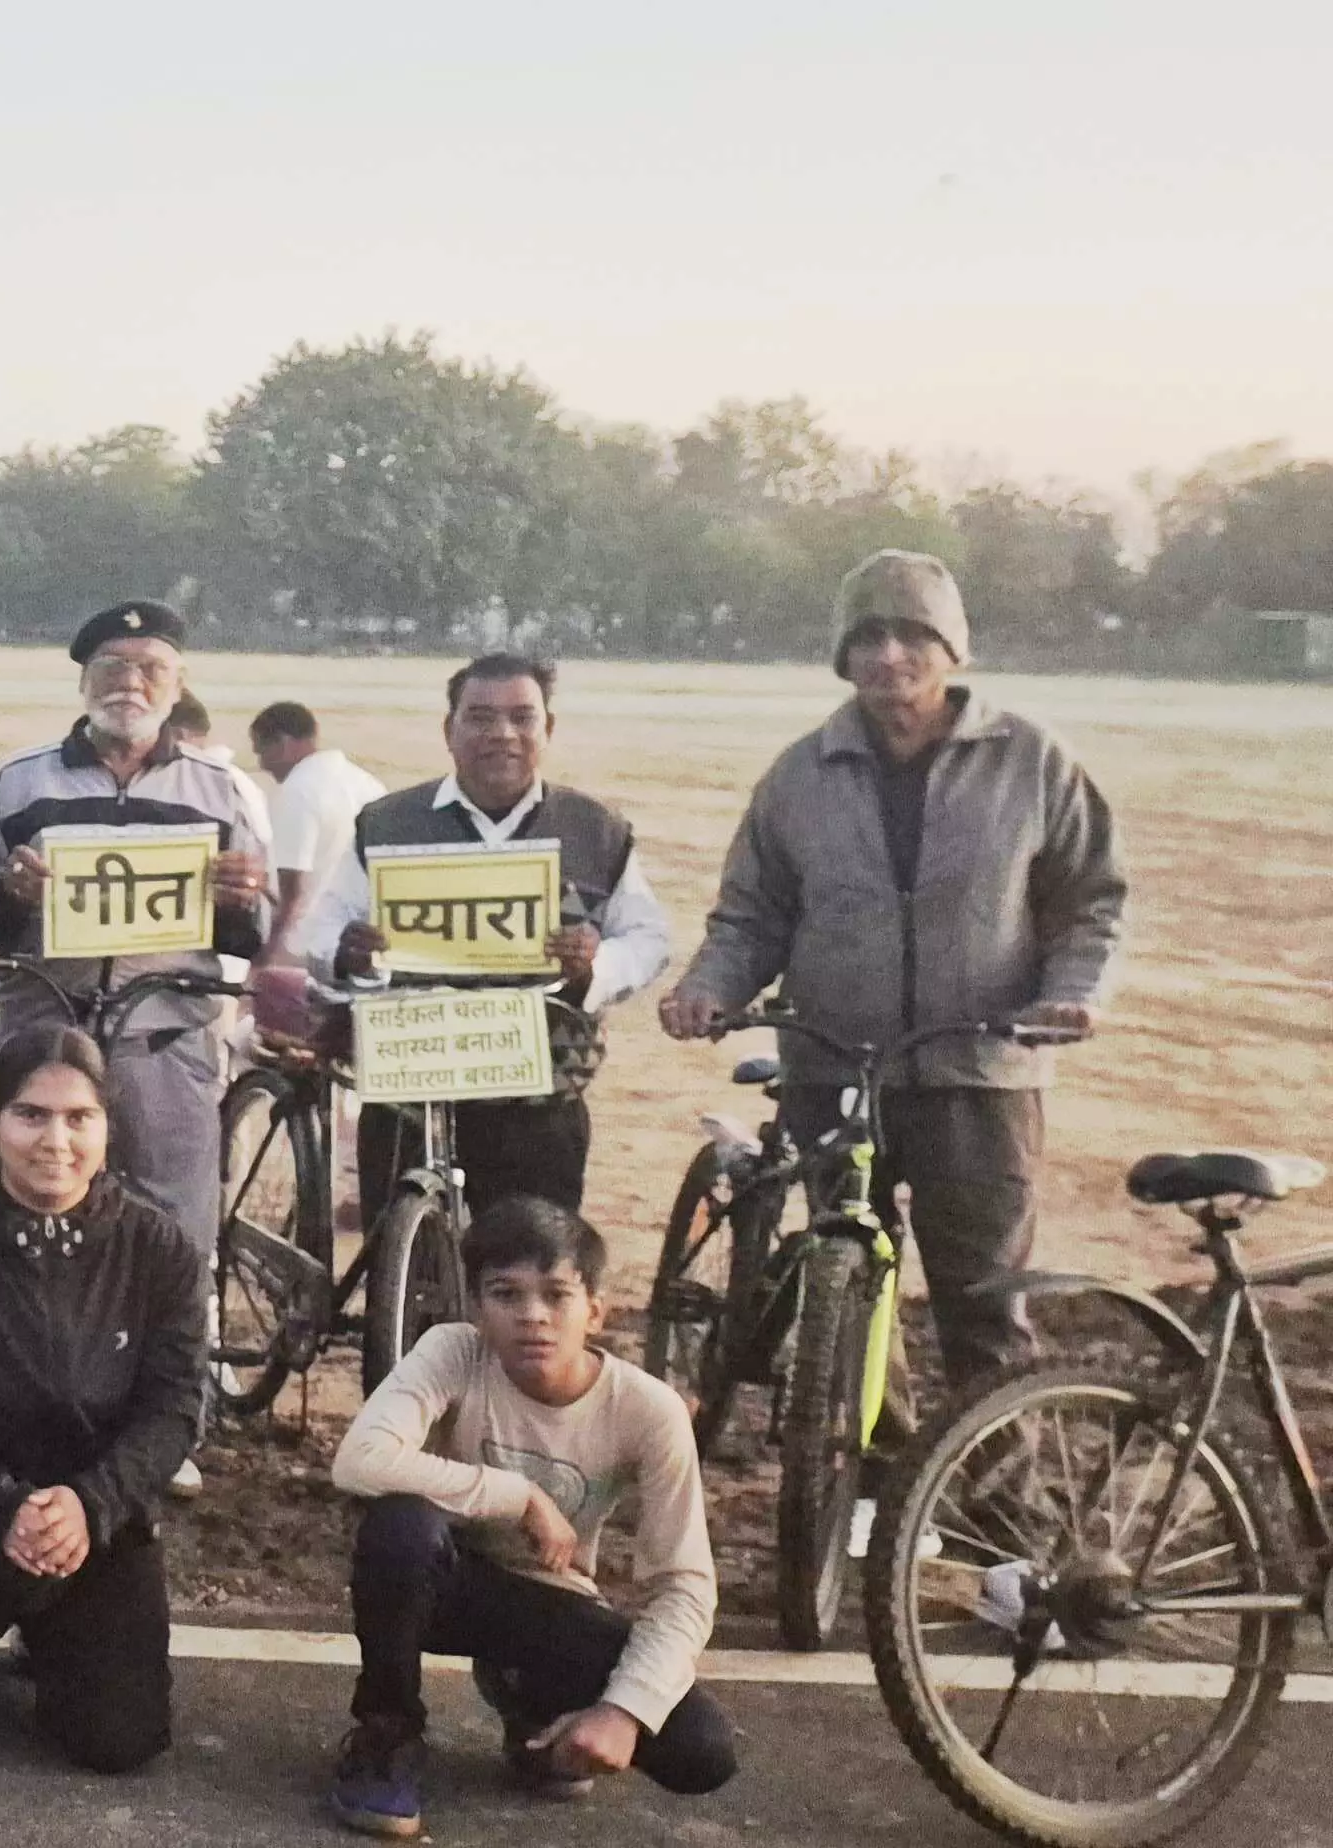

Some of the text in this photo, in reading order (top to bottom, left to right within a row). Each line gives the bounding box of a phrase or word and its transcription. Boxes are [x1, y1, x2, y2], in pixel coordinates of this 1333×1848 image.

[65, 852, 195, 925] गीत
[385, 894, 542, 941] प्यारा
[454, 1023, 522, 1053] बनाओ
[463, 1055, 535, 1086] बचाओ
